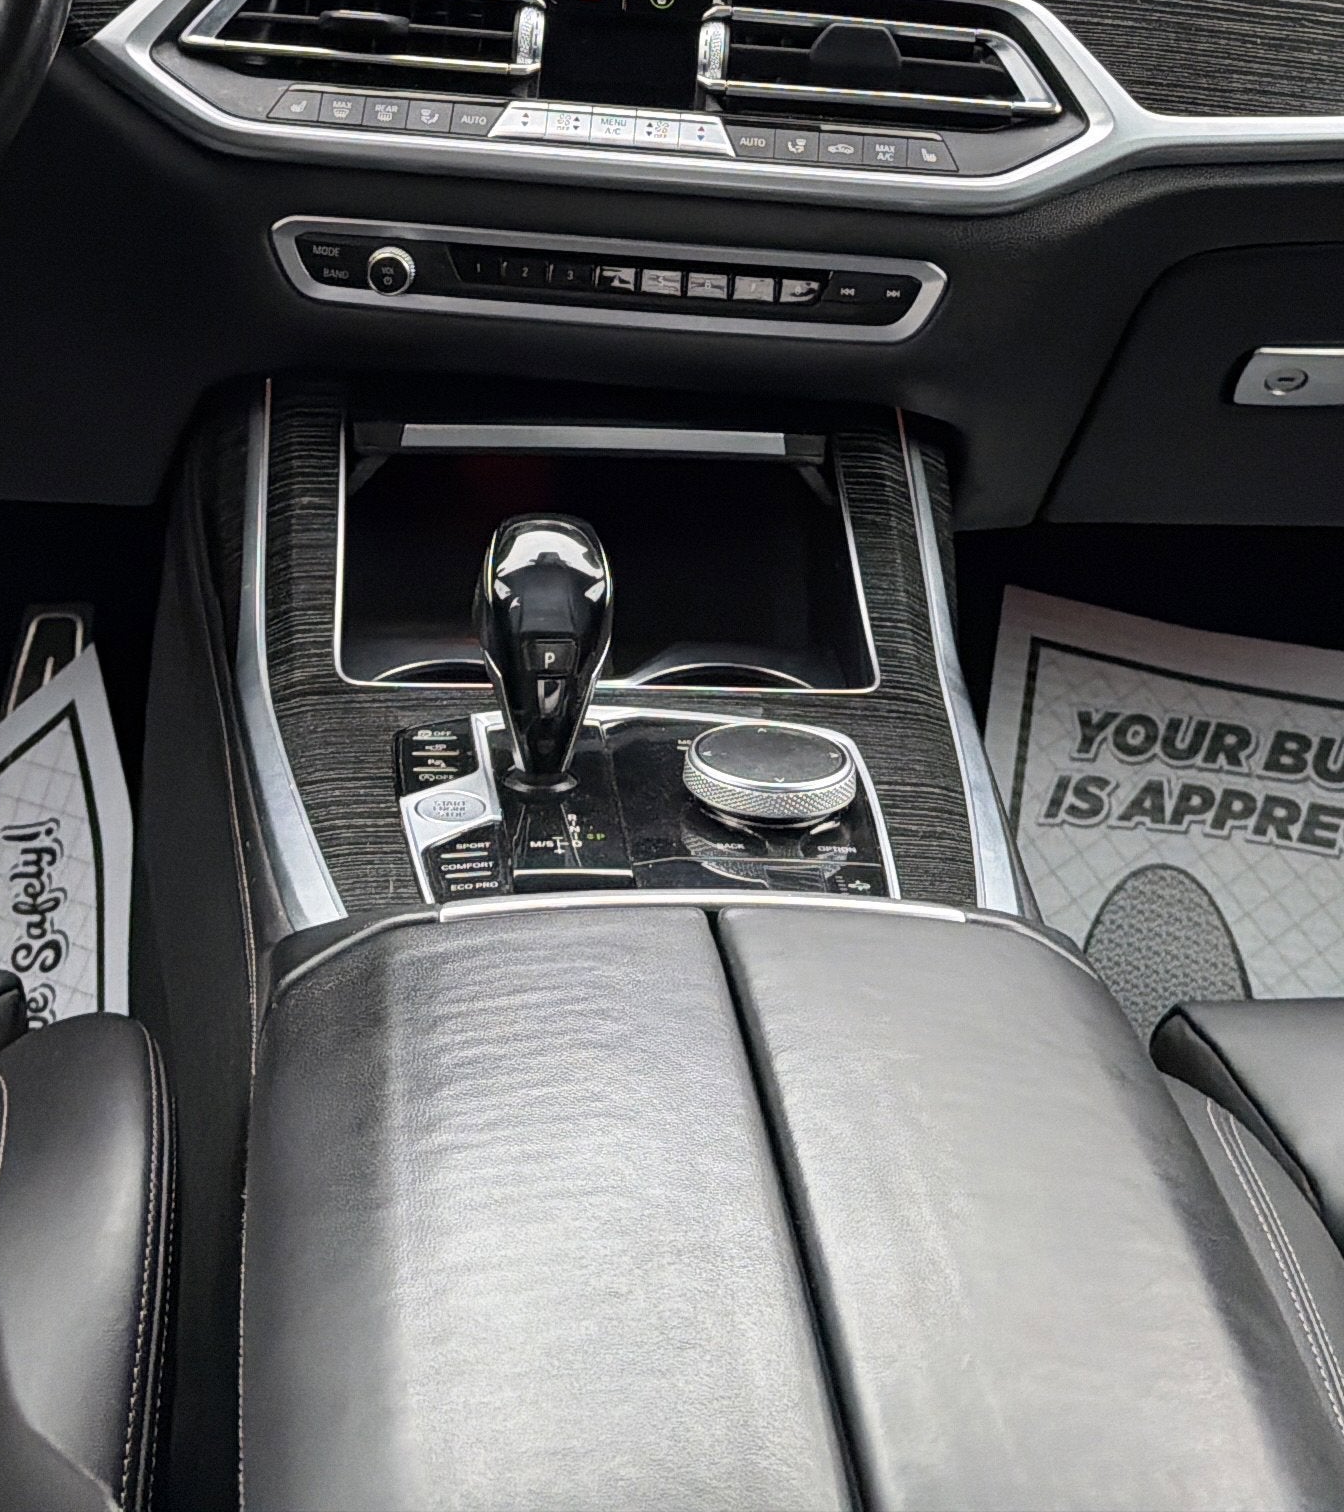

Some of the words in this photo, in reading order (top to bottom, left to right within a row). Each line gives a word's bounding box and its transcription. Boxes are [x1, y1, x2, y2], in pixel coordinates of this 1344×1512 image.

[332, 101, 353, 110] MAX
[375, 104, 398, 113] REAR
[460, 115, 487, 126] AUTO
[739, 137, 766, 149] AUTO
[875, 143, 896, 153] MAX
[877, 152, 895, 162] A/C
[312, 245, 341, 257] MODE
[323, 268, 349, 280] BAND
[522, 267, 529, 277] 2
[567, 270, 574, 280] 3
[545, 652, 556, 669] P
[1074, 709, 1256, 772] YOUR
[1044, 773, 1121, 823] IS
[456, 841, 491, 849] SPORT
[817, 845, 856, 854] OPTION
[441, 861, 494, 871] COMFORT
[450, 883, 473, 891] ECO
[475, 881, 498, 889] PRO
[2, 826, 60, 973] Safely!
